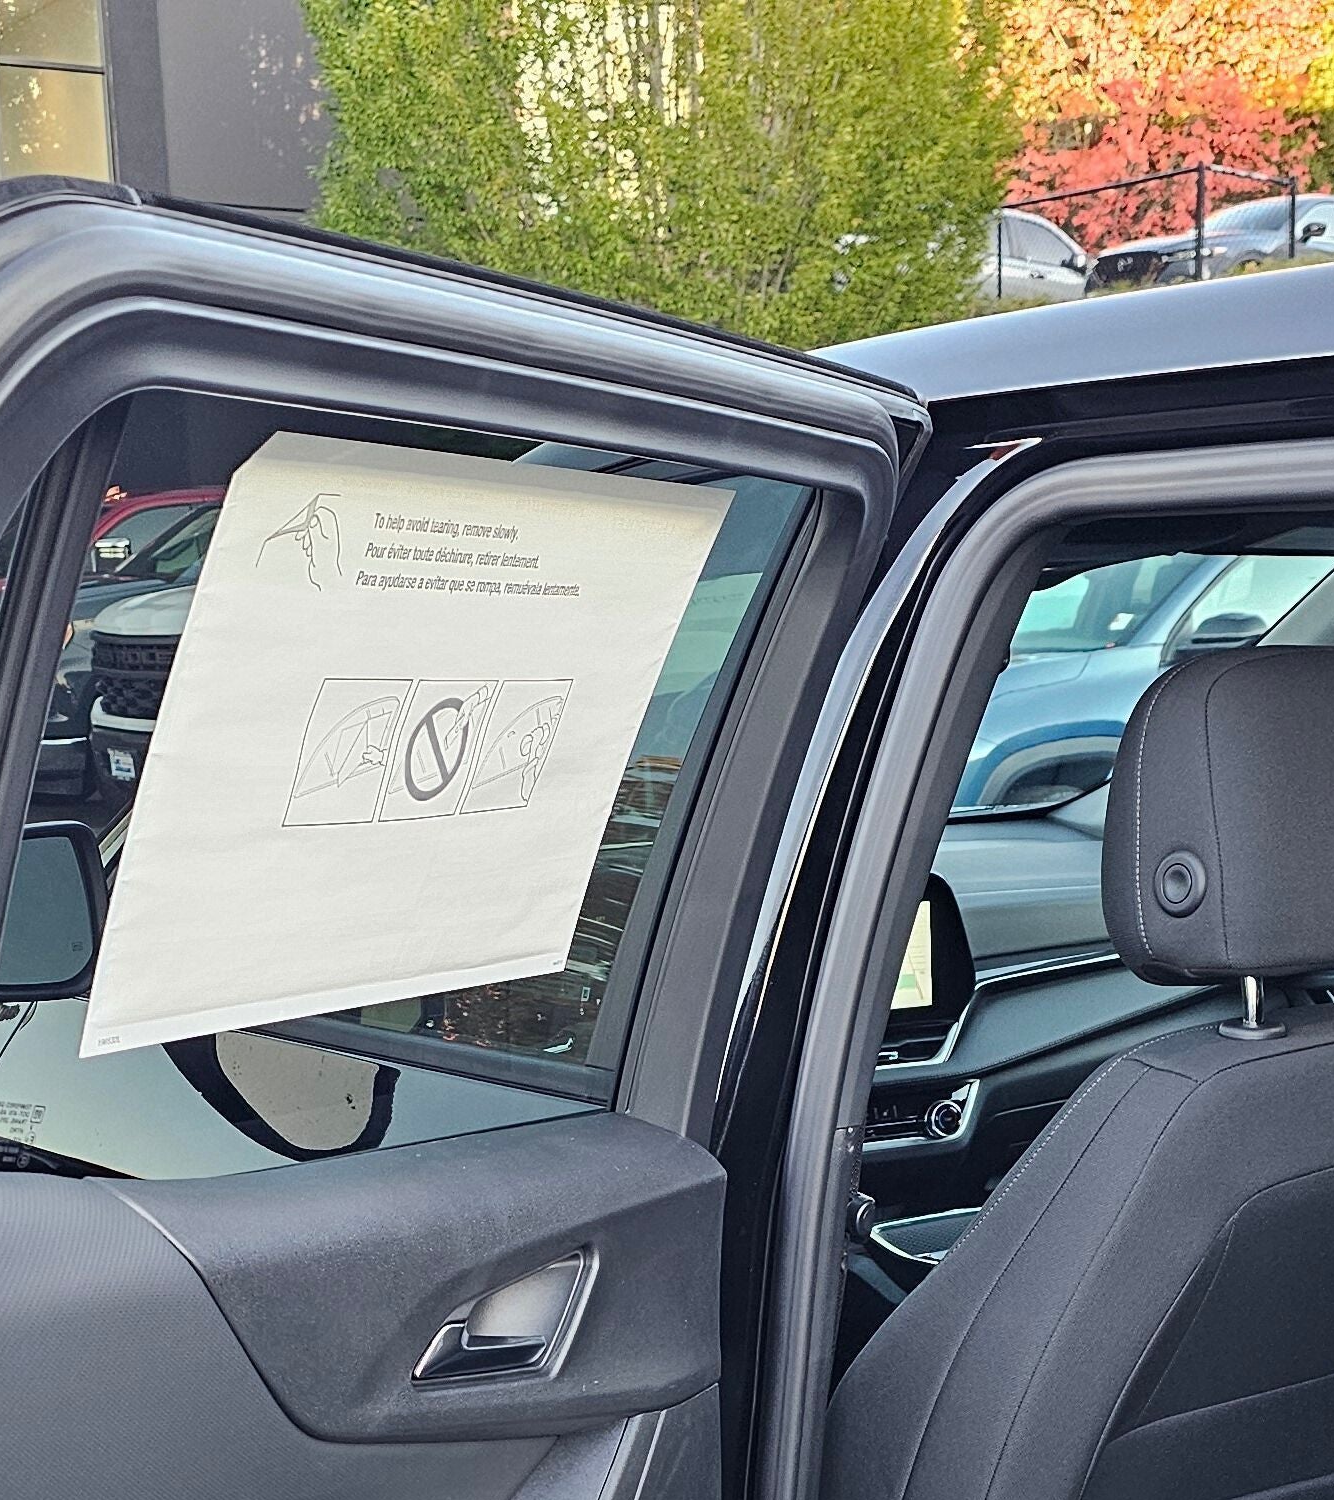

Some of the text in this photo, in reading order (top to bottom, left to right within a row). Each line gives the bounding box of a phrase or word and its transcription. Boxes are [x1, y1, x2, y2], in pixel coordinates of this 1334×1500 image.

[373, 512, 519, 543] To help avoid tearing, remove slowly.
[364, 542, 387, 559] Pour
[387, 543, 412, 560] éviter
[412, 545, 435, 562] toute
[434, 547, 474, 567] déchirure,
[475, 551, 501, 567] retirer
[355, 570, 377, 587] Para
[378, 573, 417, 591] ayudarse
[417, 577, 425, 589] a
[424, 575, 449, 590] evitar
[448, 580, 465, 594] que
[465, 580, 475, 592] se
